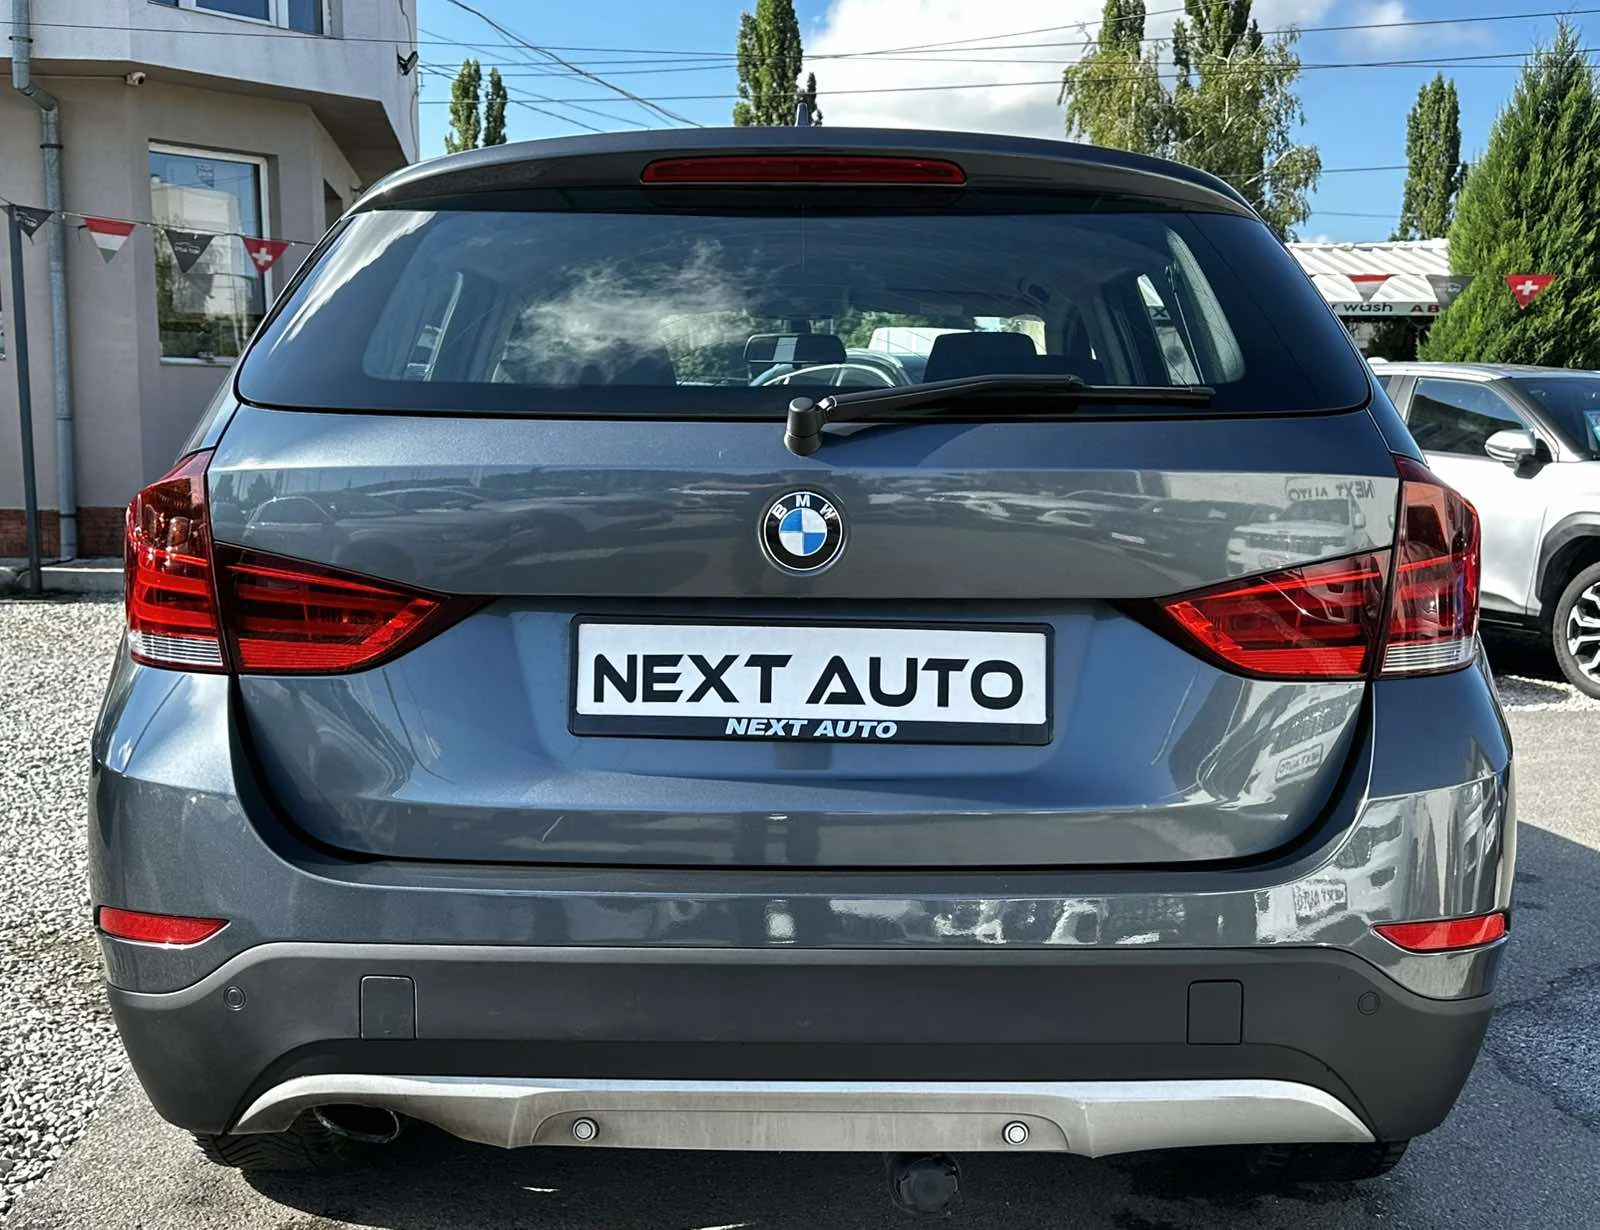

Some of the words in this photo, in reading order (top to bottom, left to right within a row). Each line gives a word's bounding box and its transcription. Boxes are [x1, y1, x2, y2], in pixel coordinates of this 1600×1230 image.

[1343, 302, 1393, 312] wash
[772, 494, 836, 520] BMW
[594, 653, 792, 703] NEXT
[805, 655, 1024, 710] AUTO
[725, 718, 807, 736] NEXT
[813, 720, 897, 738] AUTO
